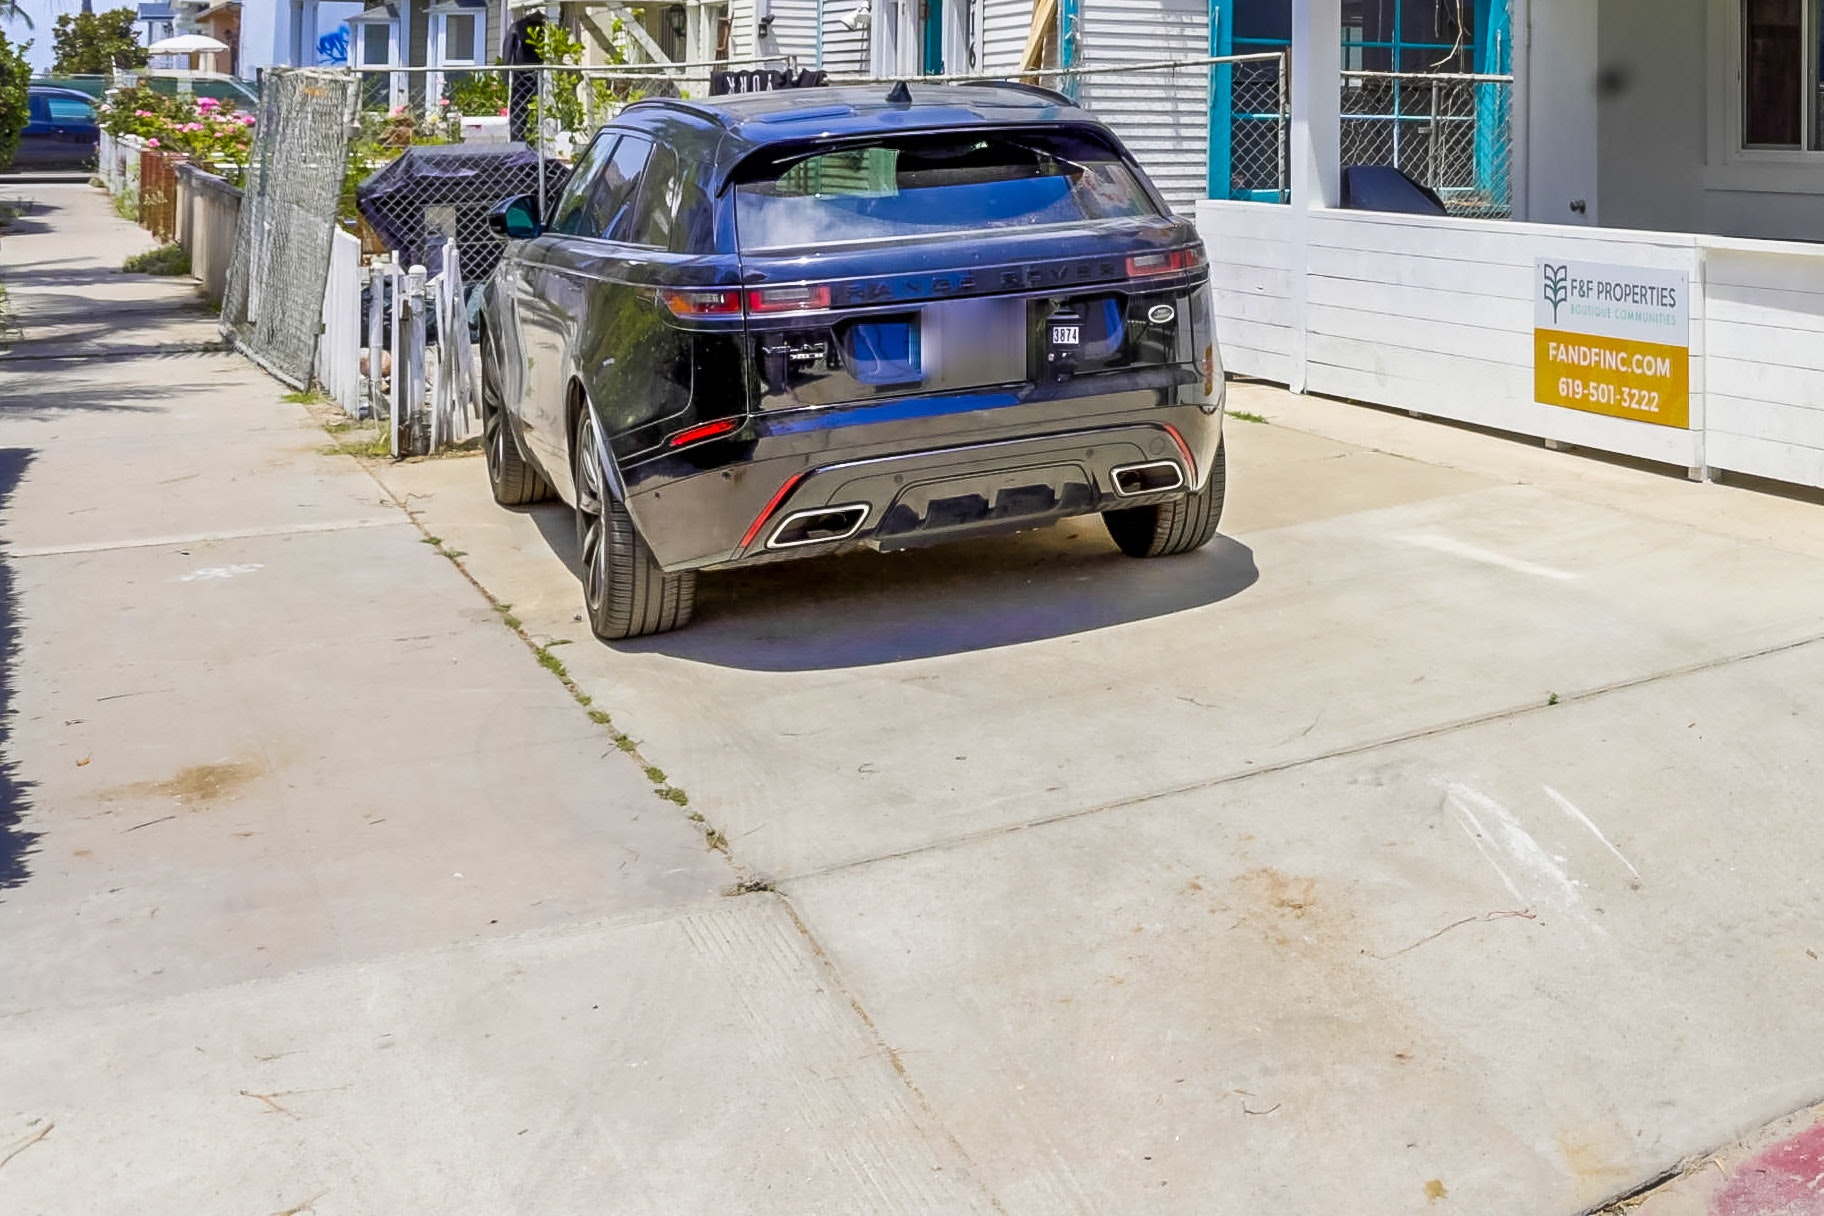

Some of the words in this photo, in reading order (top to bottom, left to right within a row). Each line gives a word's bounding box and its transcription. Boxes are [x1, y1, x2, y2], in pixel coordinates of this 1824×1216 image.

[1570, 278, 1594, 299] F&F
[1597, 281, 1677, 309] PROPERTIES
[1570, 303, 1611, 320] BOUTIQUE
[1615, 308, 1677, 326] COMMUNITIES
[1053, 327, 1079, 343] 3874
[1548, 342, 1671, 378] FANDFINC.COM
[1558, 377, 1660, 412] 619-501-3222
